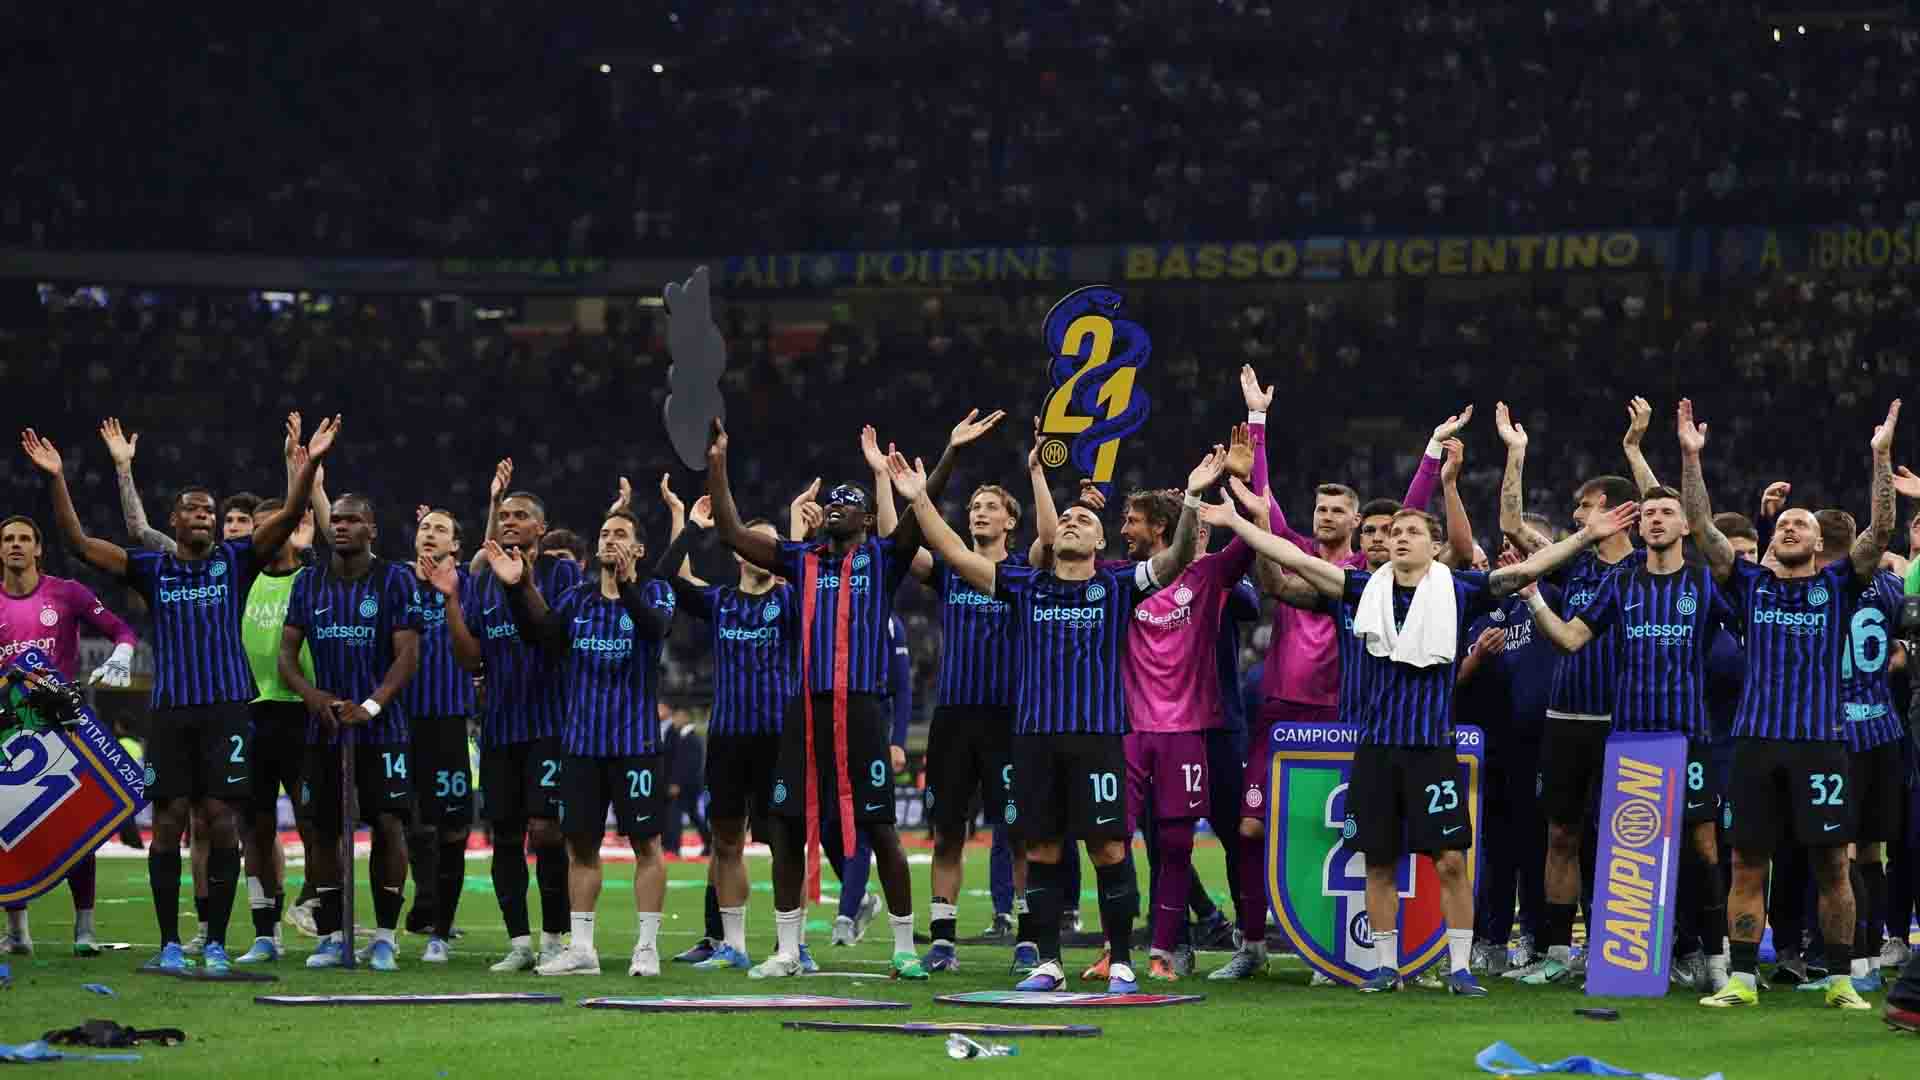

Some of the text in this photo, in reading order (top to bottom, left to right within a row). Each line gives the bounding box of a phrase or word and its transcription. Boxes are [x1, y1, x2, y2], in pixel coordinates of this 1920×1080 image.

[1124, 232, 1640, 280] BASSO VICENTINO
[1042, 315, 1137, 483] 21
[160, 584, 228, 602] betsson
[1034, 606, 1104, 622] betsson
[1068, 620, 1102, 630] sport
[1754, 608, 1827, 626] betsson
[316, 623, 376, 640] betsson
[572, 634, 633, 650] betsson
[1626, 620, 1693, 639] betsson
[229, 735, 245, 762] 2
[1273, 727, 1358, 744] CAMPIONI
[382, 752, 407, 779] 14
[870, 760, 886, 787] 9
[1181, 763, 1202, 792] 12
[1687, 761, 1704, 791] 8
[435, 770, 467, 797] 36
[626, 769, 652, 798] 20
[1089, 772, 1118, 802] 10
[1425, 780, 1459, 814] 23
[1809, 773, 1844, 805] 32
[1602, 756, 1665, 972] CAMPIONI
